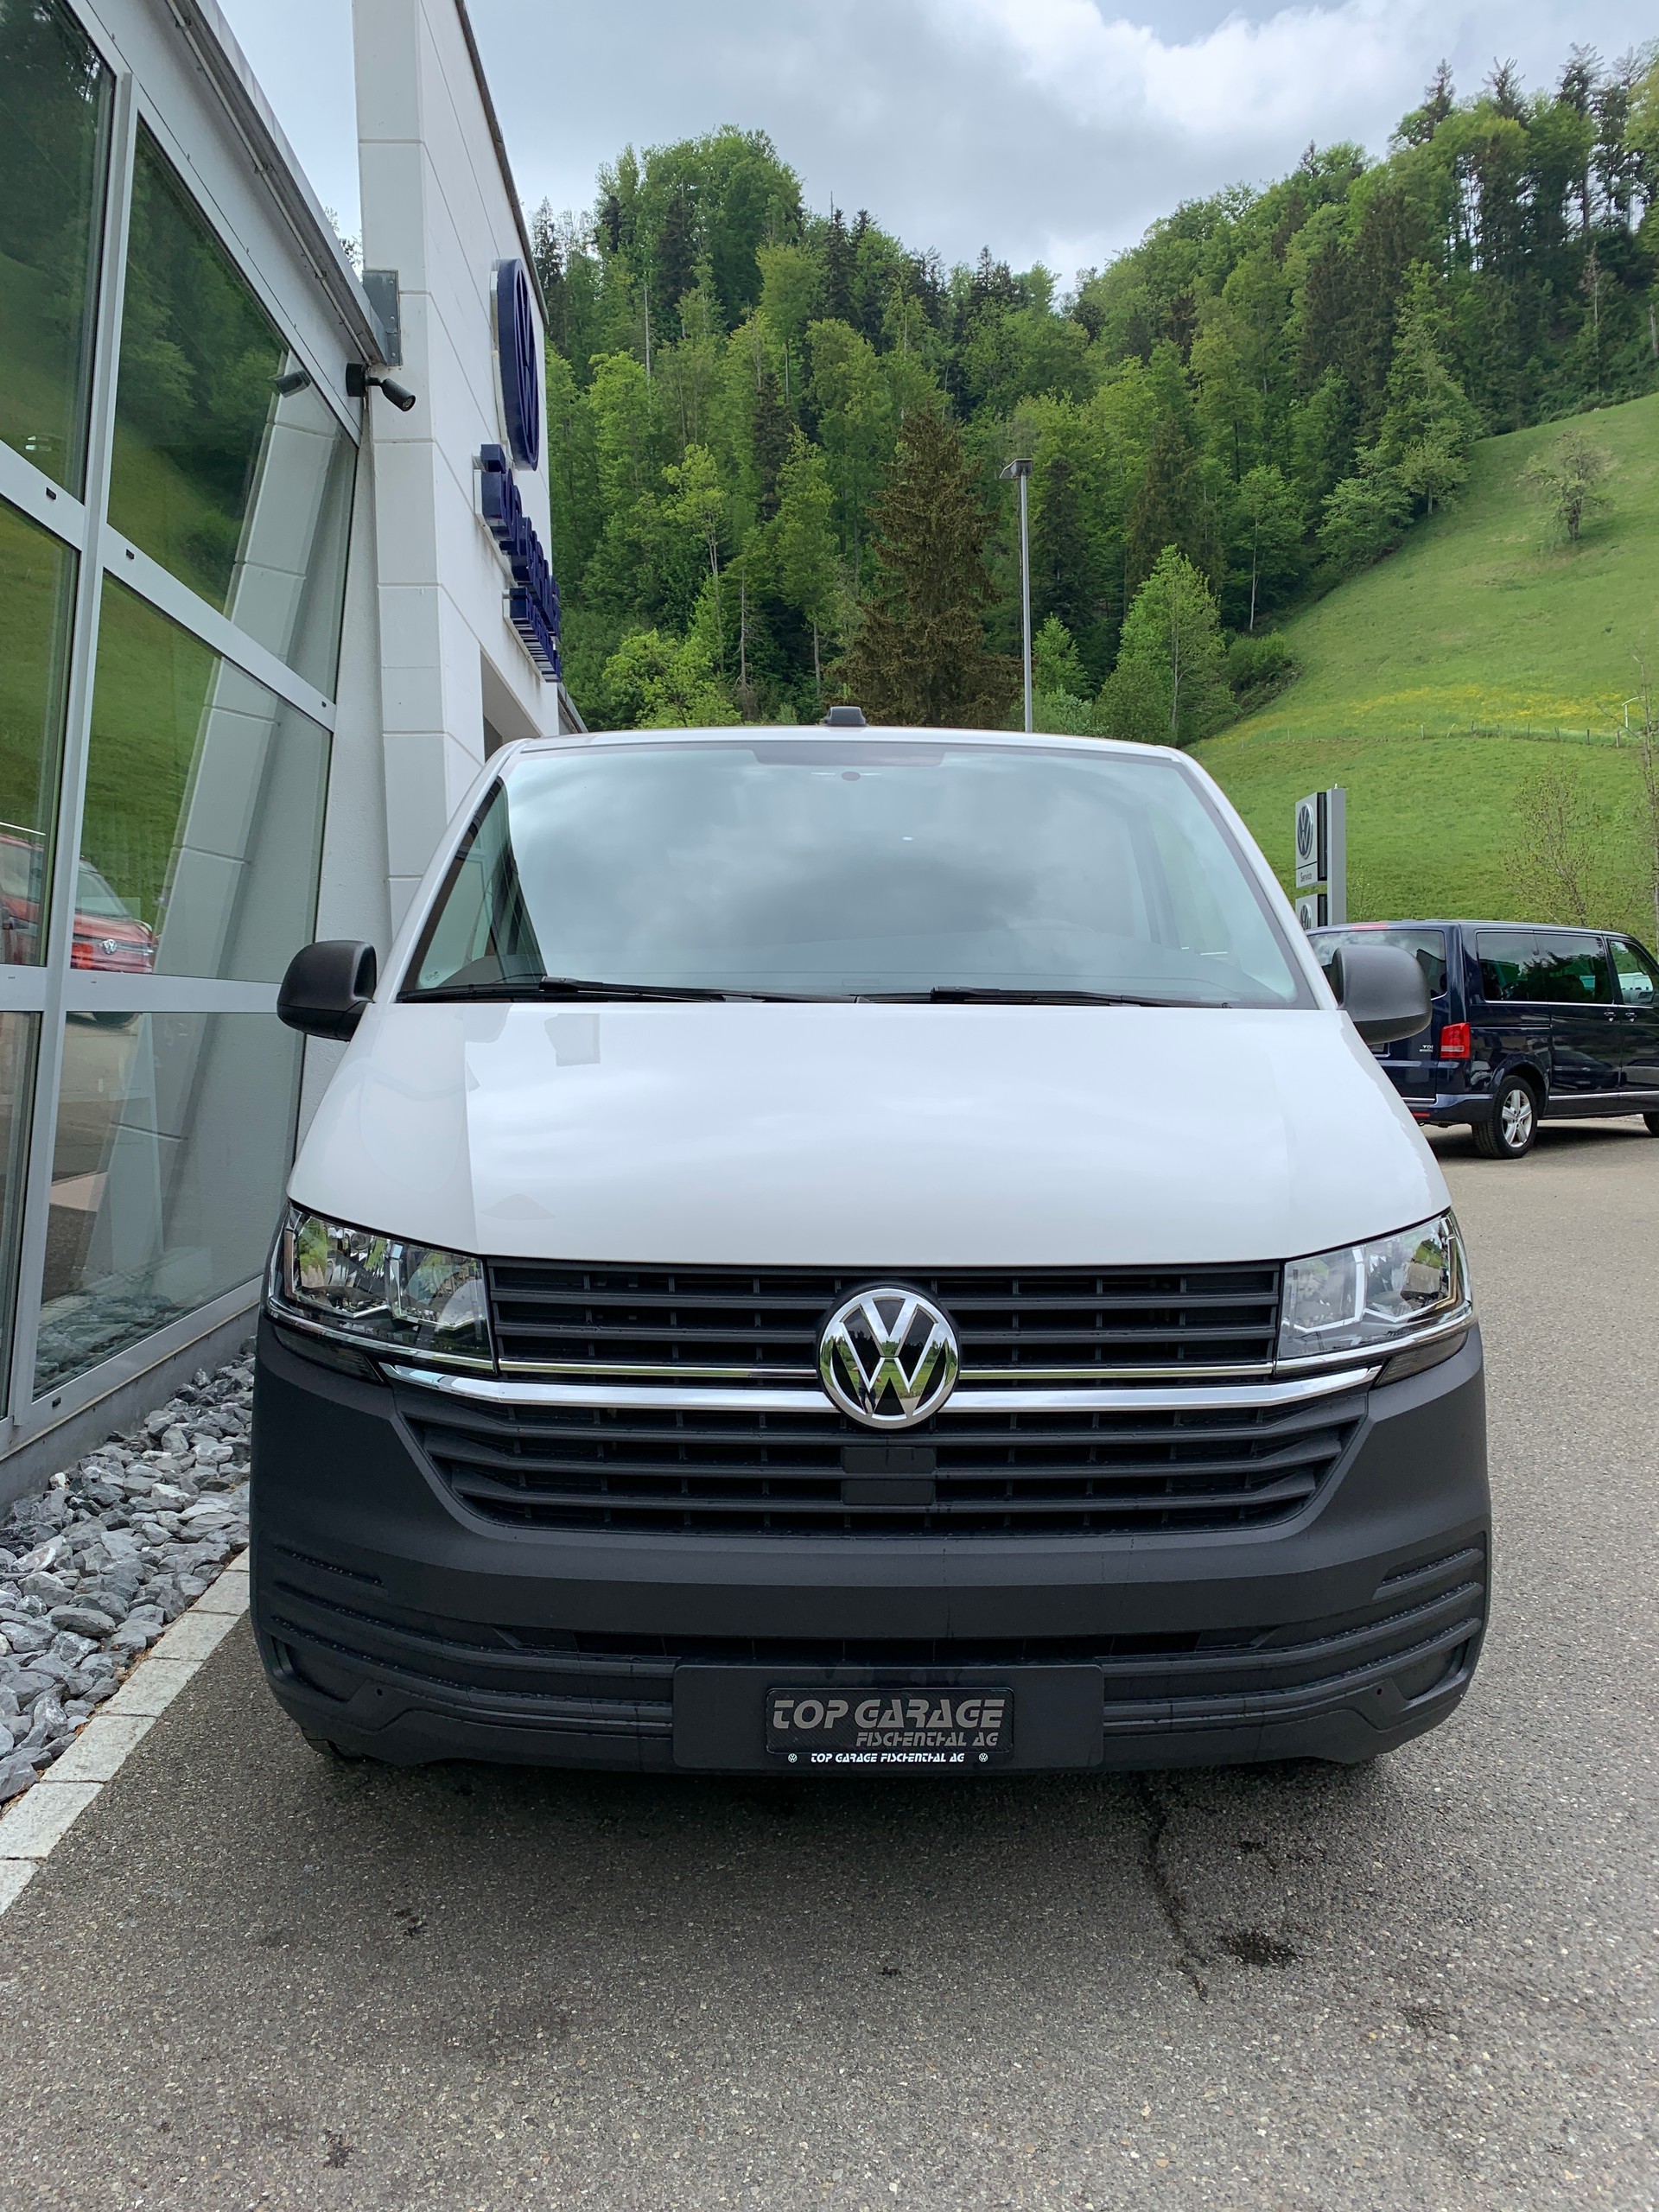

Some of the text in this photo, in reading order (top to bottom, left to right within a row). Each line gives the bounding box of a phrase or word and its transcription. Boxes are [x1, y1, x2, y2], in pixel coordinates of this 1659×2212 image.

[1300, 872, 1312, 882] Service
[820, 1288, 958, 1429] VW
[773, 1699, 1005, 1729] TOP GARAGE
[855, 1732, 999, 1746] FISCHENTHAL AG
[811, 1753, 833, 1763] TOP
[835, 1753, 878, 1763] GARAGE
[880, 1753, 947, 1763] FISCHENTHAL
[949, 1753, 965, 1763] AG
